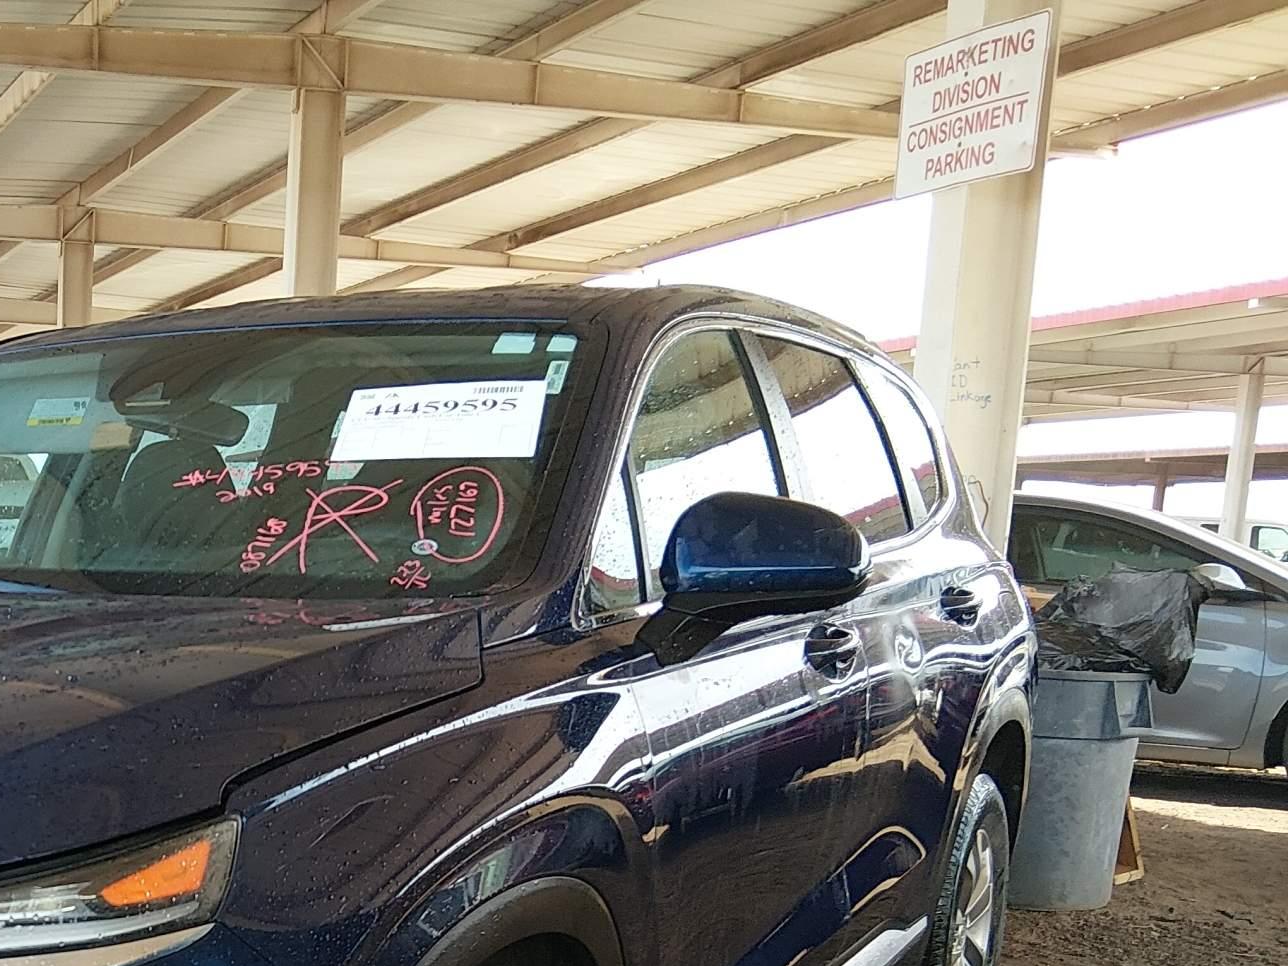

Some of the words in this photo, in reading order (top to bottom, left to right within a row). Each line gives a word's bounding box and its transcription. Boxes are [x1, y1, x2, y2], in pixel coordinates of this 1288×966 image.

[912, 28, 1036, 88] REMARKETING
[932, 71, 1003, 114] DIVISION
[906, 99, 1029, 153] CONSIGNMENT
[924, 142, 996, 181] PARKING
[365, 397, 519, 416] 44459595
[215, 481, 275, 503] 2019
